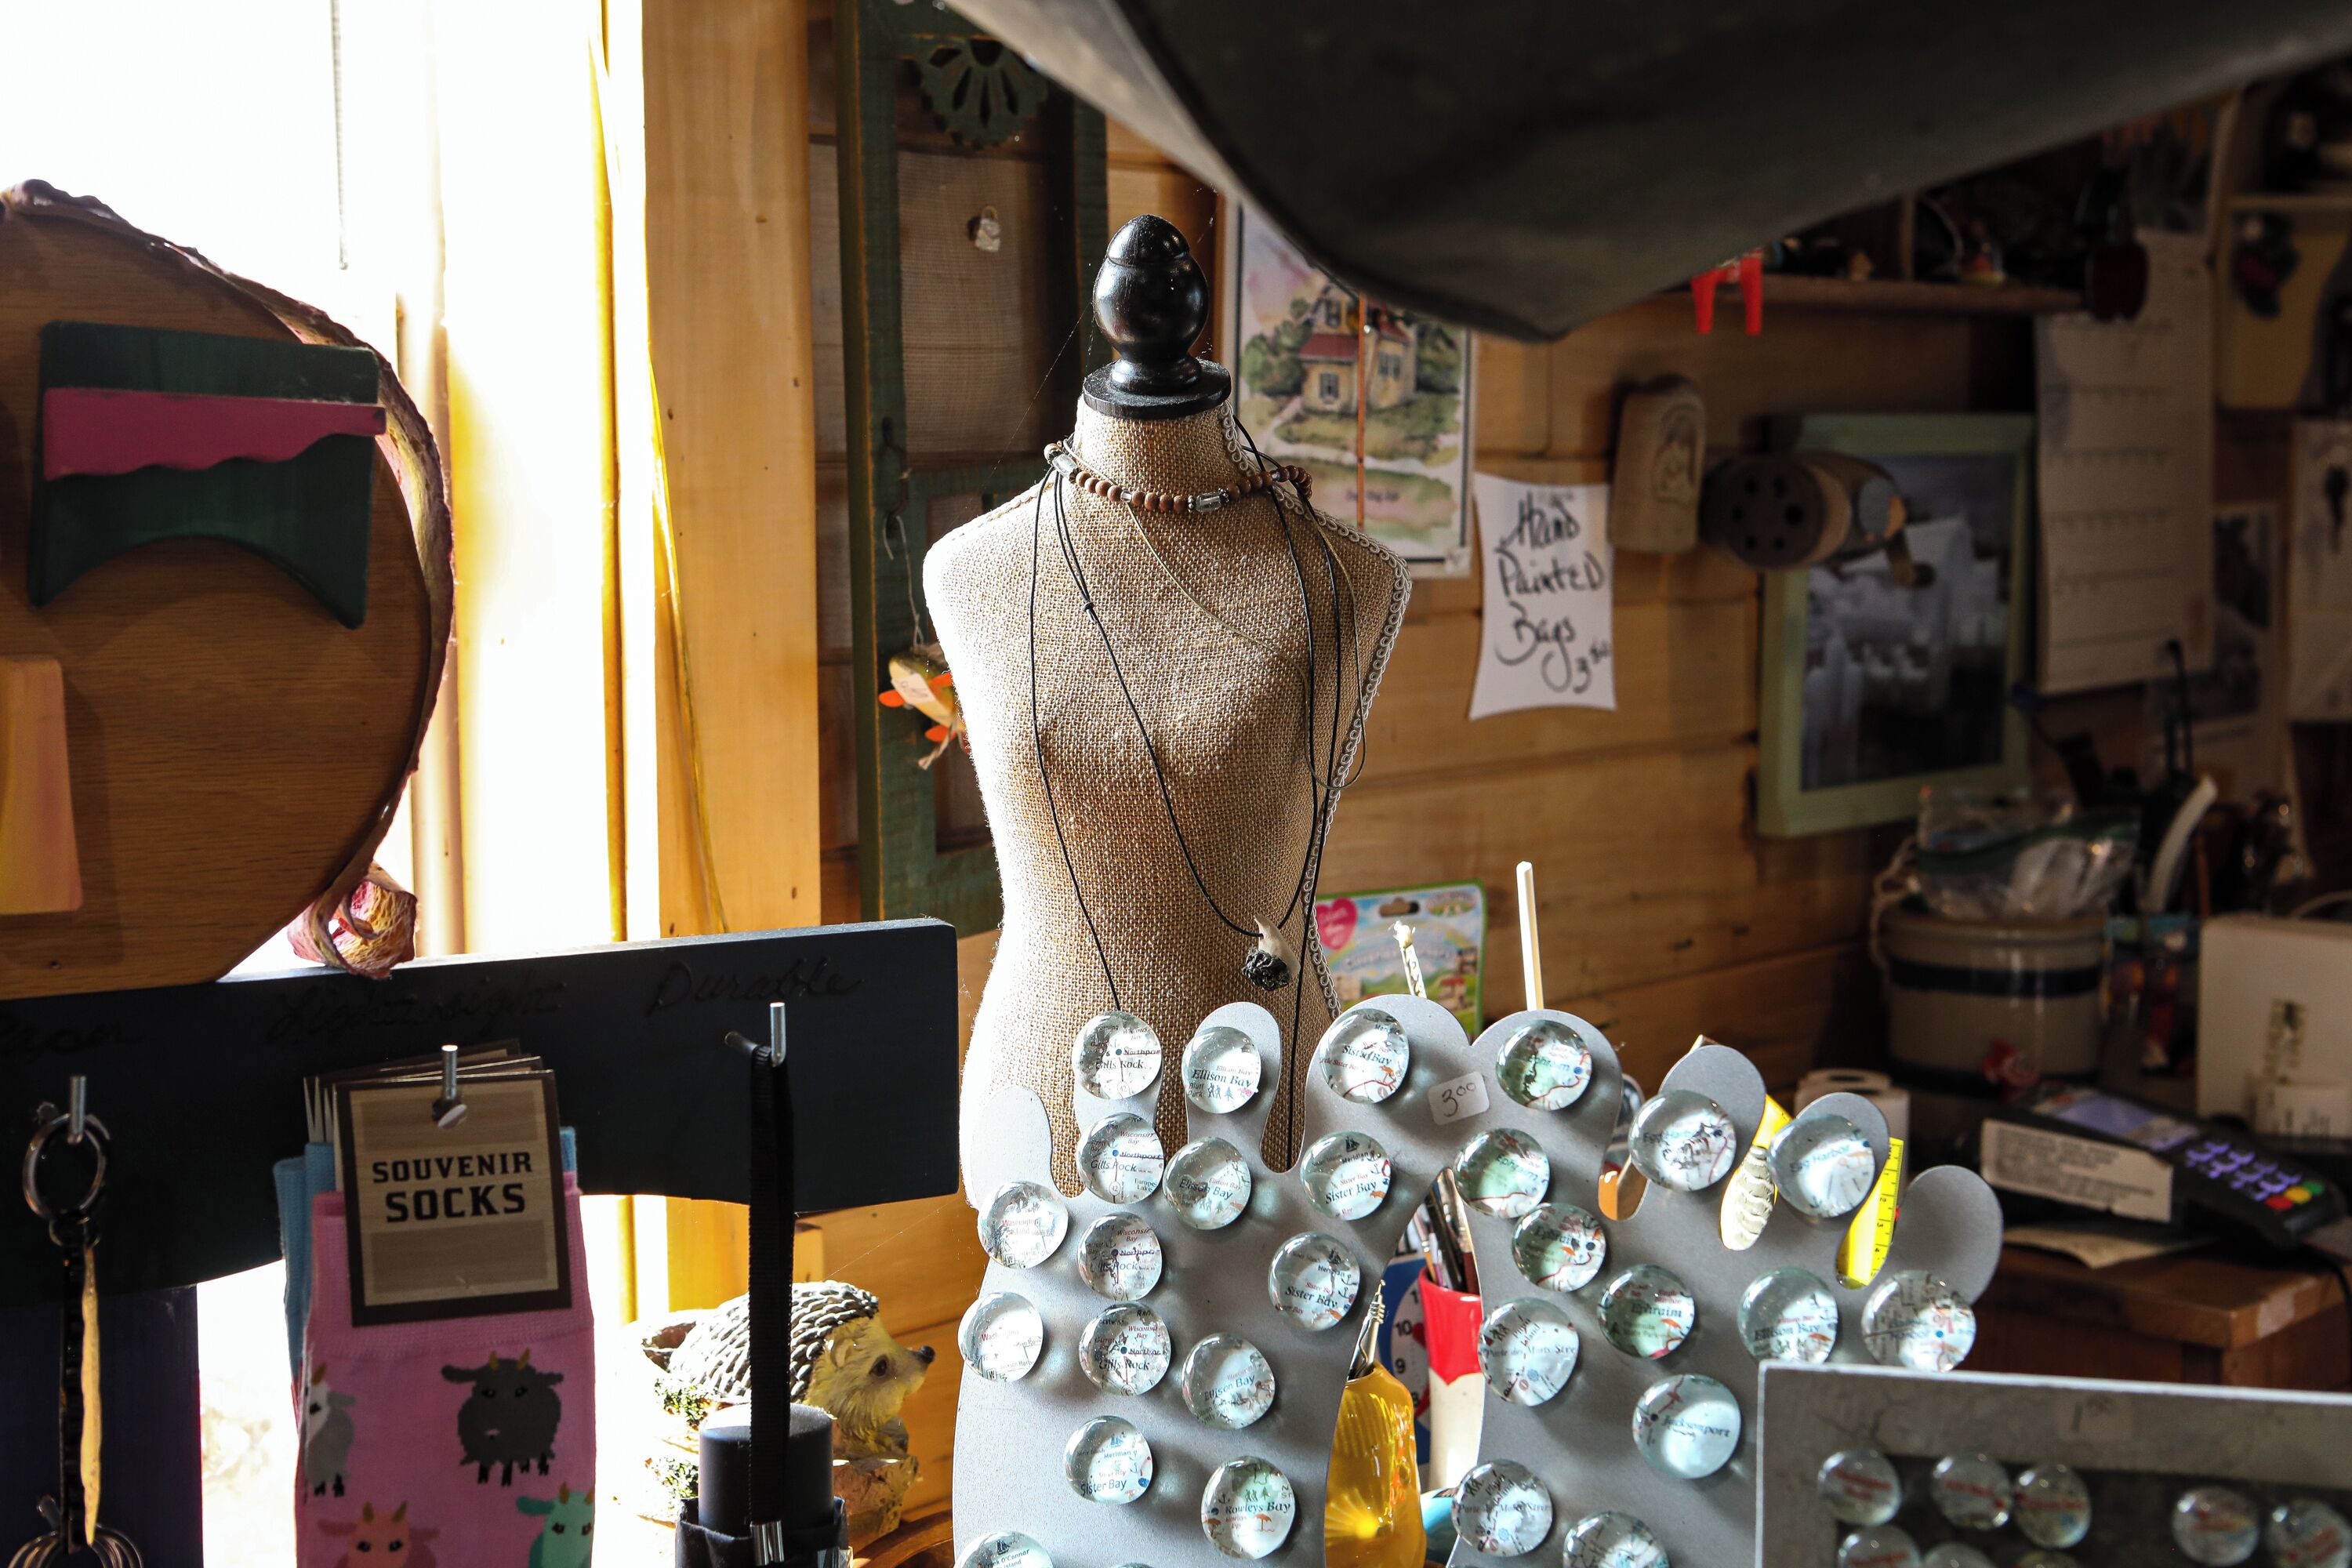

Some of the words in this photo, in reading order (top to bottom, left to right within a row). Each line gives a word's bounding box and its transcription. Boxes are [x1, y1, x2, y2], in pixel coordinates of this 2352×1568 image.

[1192, 1069, 1227, 1083] Ellison
[1229, 1075, 1254, 1088] Bay
[372, 1152, 532, 1183] SOUVENIR
[1090, 1160, 1112, 1171] Gills
[1213, 1186, 1233, 1201] Bay
[1326, 1188, 1354, 1205] Sister
[1356, 1180, 1377, 1195] Bay
[385, 1182, 525, 1223] SOCKS
[1285, 1285, 1315, 1301] Sister
[1395, 1319, 1411, 1336] 10
[1755, 1327, 1795, 1341] Ellison
[1395, 1358, 1406, 1374] 9
[1204, 1384, 1234, 1401] Ellison
[1235, 1374, 1255, 1388] Bay
[1104, 1450, 1131, 1459] Meridian
[1080, 1482, 1108, 1497] Sister
[1108, 1479, 1127, 1492] Bay
[1225, 1504, 1264, 1515] Rowleys
[1266, 1501, 1291, 1514] Bay
